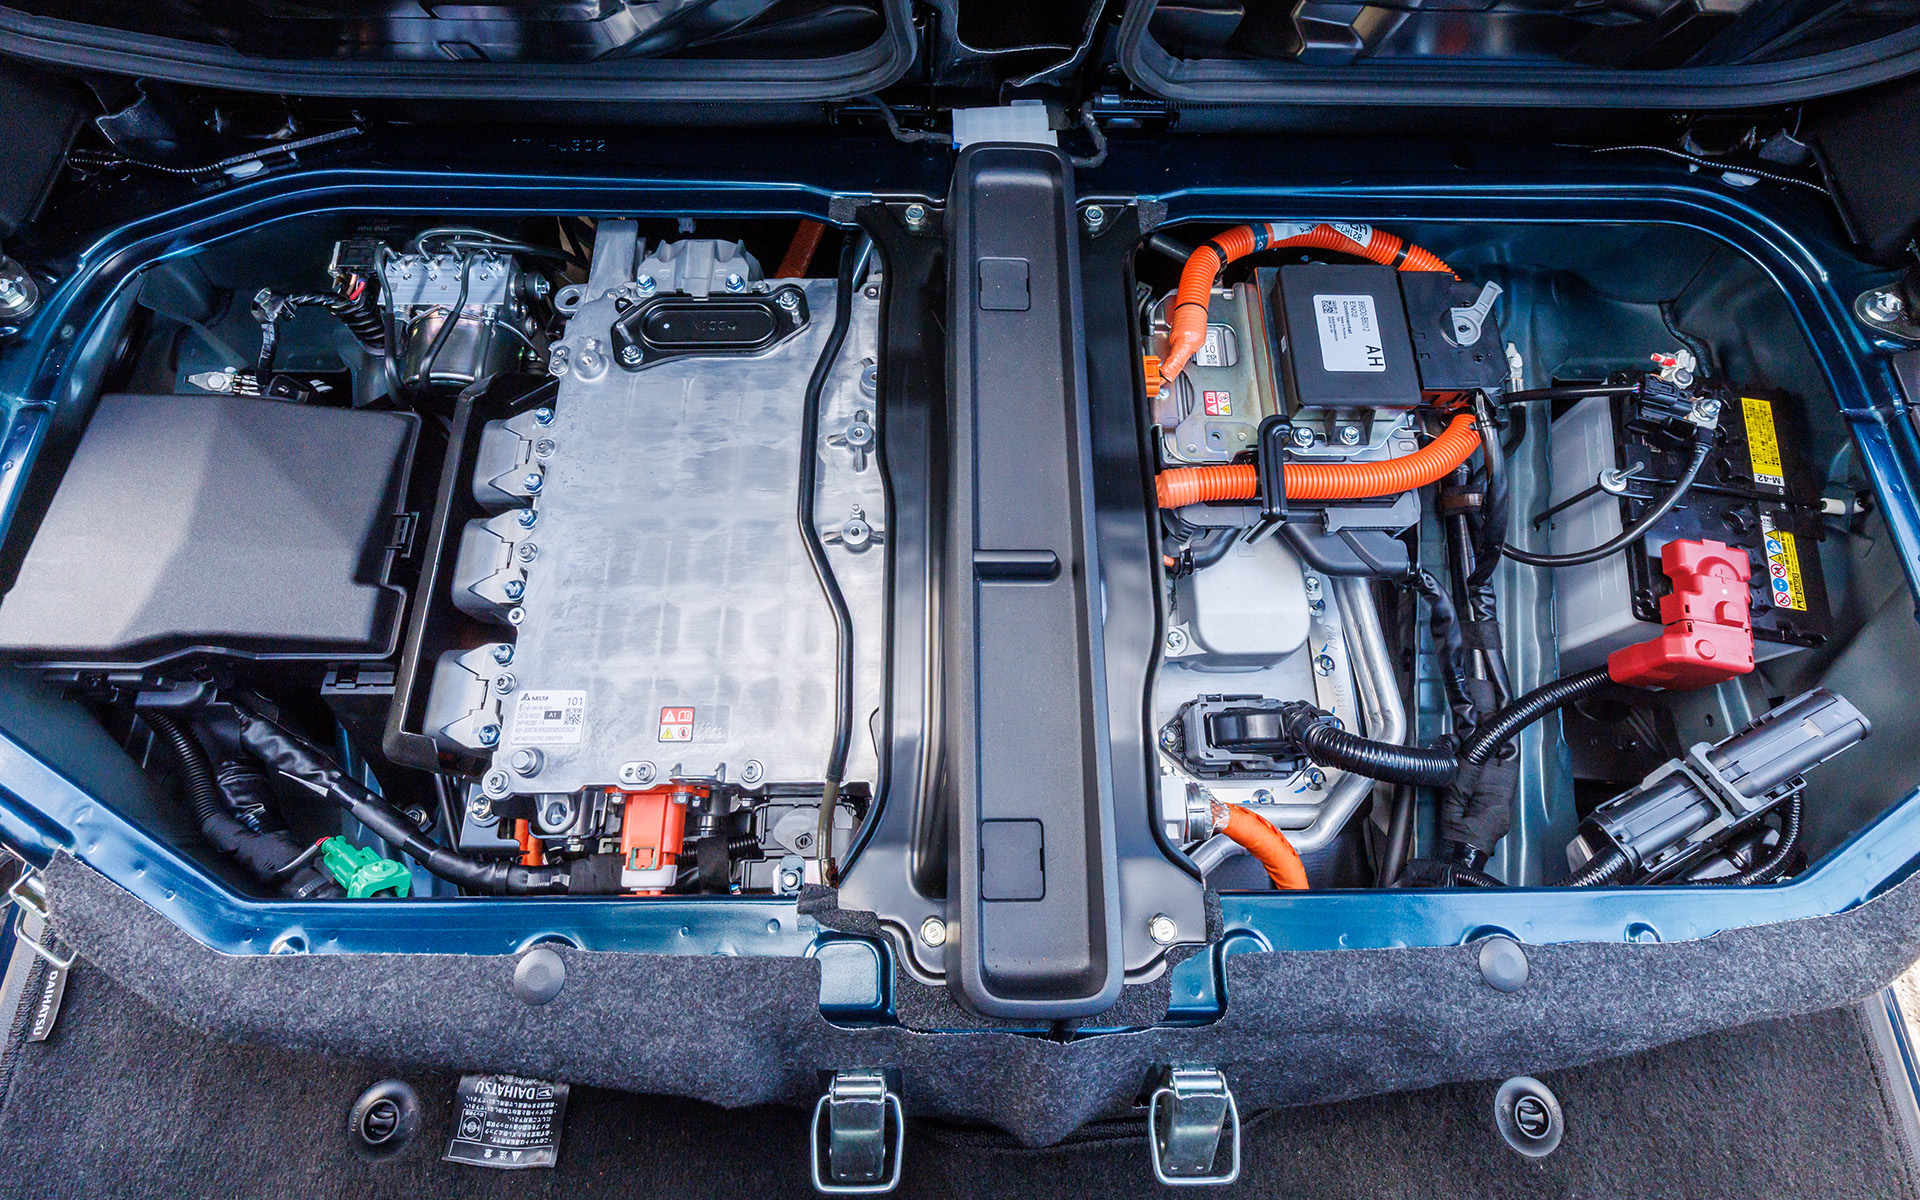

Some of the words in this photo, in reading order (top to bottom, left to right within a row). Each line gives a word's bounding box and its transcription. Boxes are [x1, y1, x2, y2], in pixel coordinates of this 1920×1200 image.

[1342, 300, 1353, 334] Continental
[1204, 344, 1216, 354] 01
[1365, 345, 1384, 366] AH
[1757, 474, 1781, 485] M-42
[567, 696, 583, 706] 101
[32, 970, 59, 1036] DAIHATSU
[474, 1080, 536, 1100] DAIHATSU
